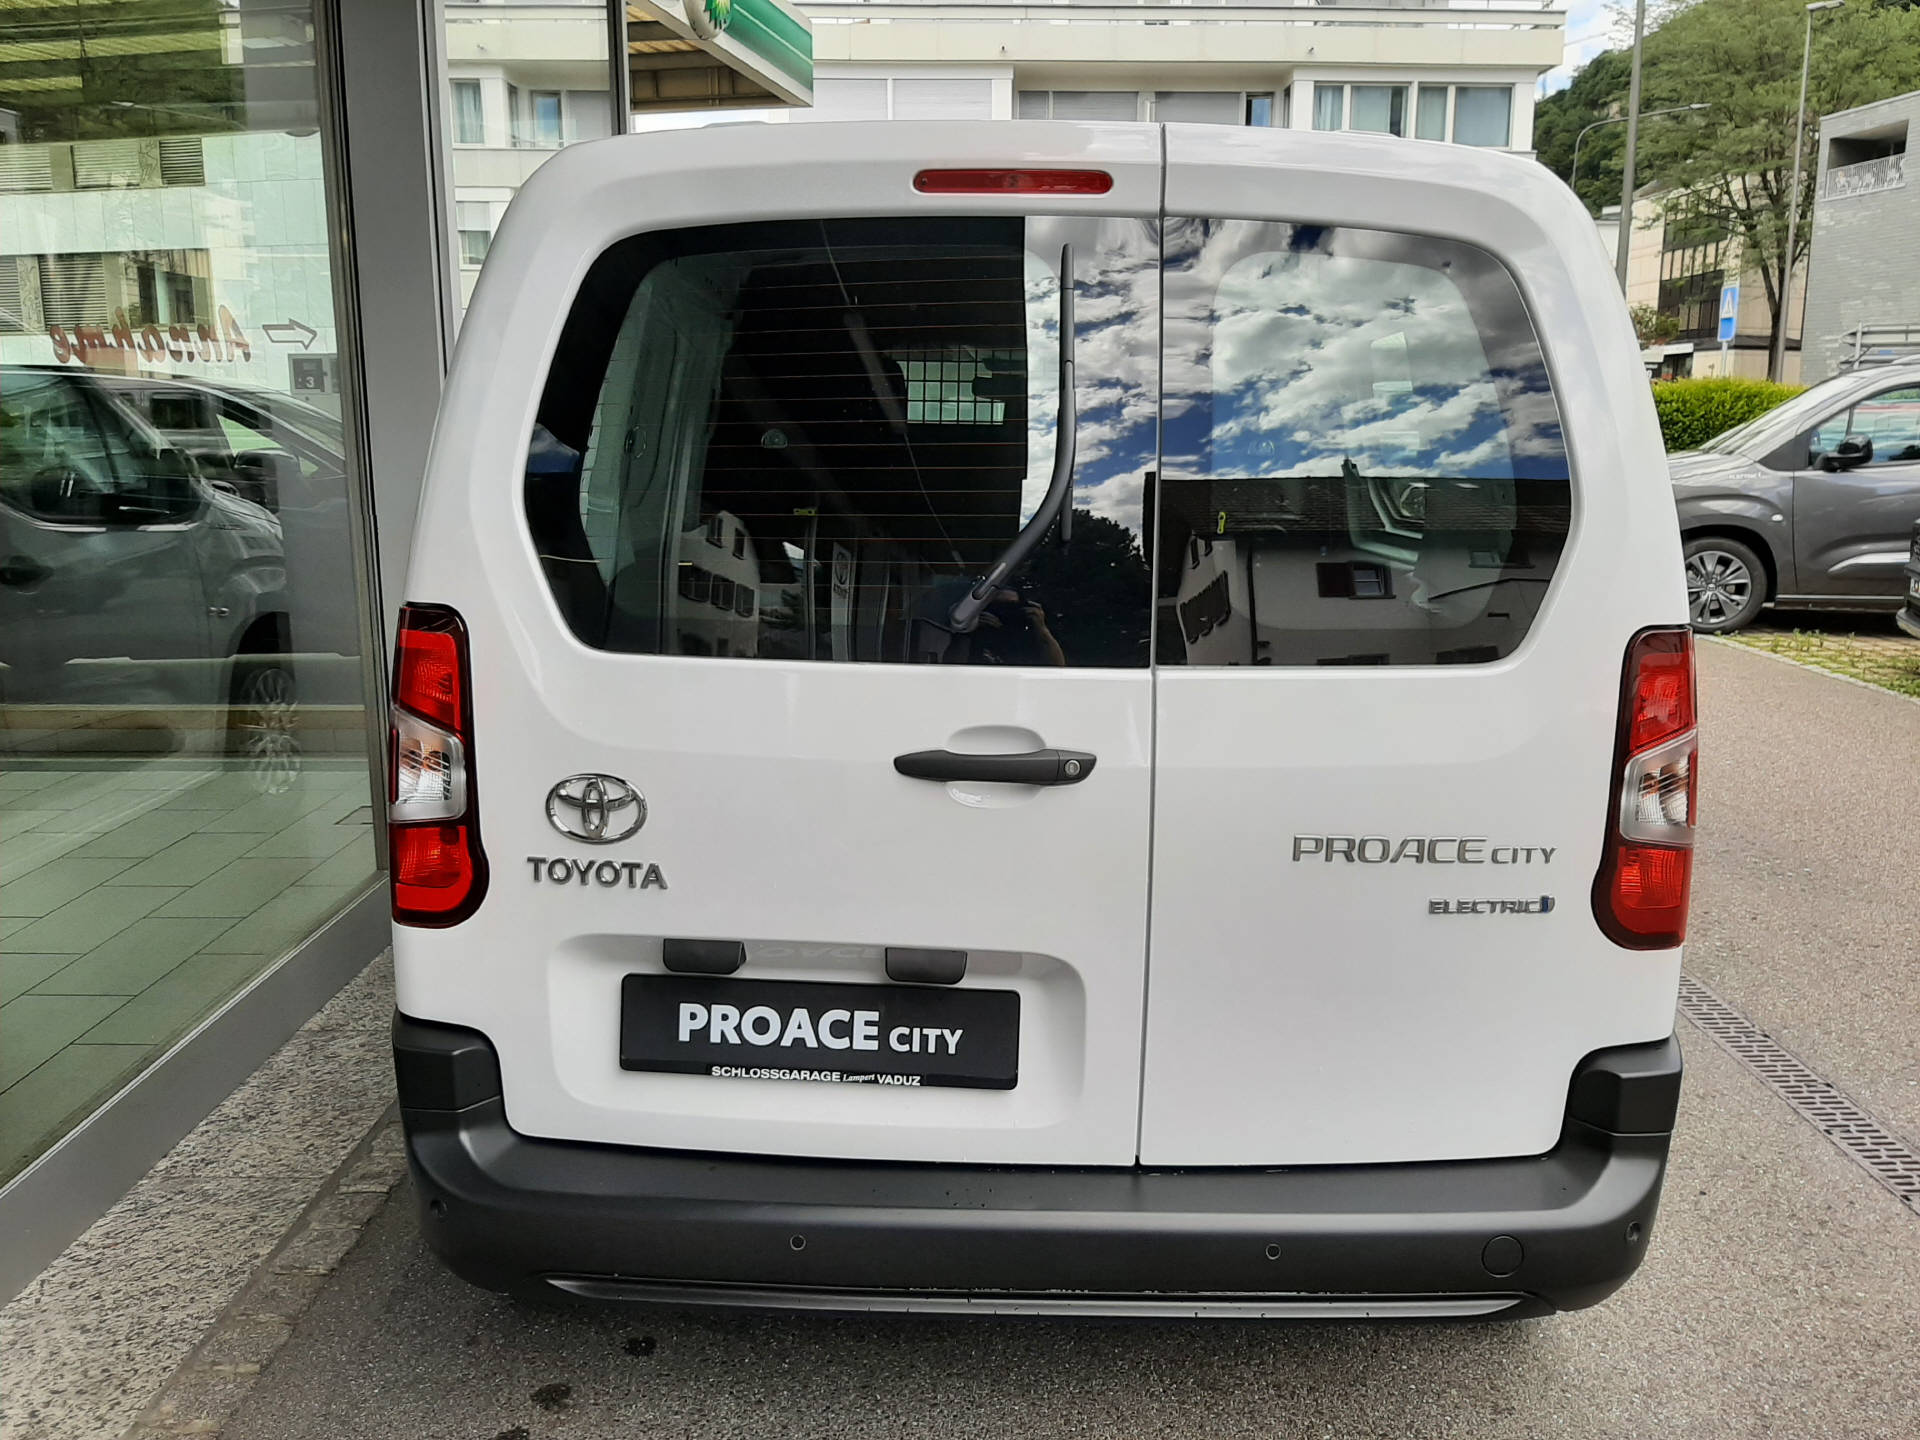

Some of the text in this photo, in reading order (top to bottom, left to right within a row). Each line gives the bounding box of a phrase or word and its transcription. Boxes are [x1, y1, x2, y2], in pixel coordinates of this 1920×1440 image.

[1292, 834, 1557, 865] PROACE CITY
[527, 856, 669, 890] TOYOTA
[1428, 898, 1541, 915] ELECTRIC
[677, 1002, 964, 1056] PROACE CITY
[711, 1065, 921, 1086] SCHLOSSGARAGE Lampert VADUZ
